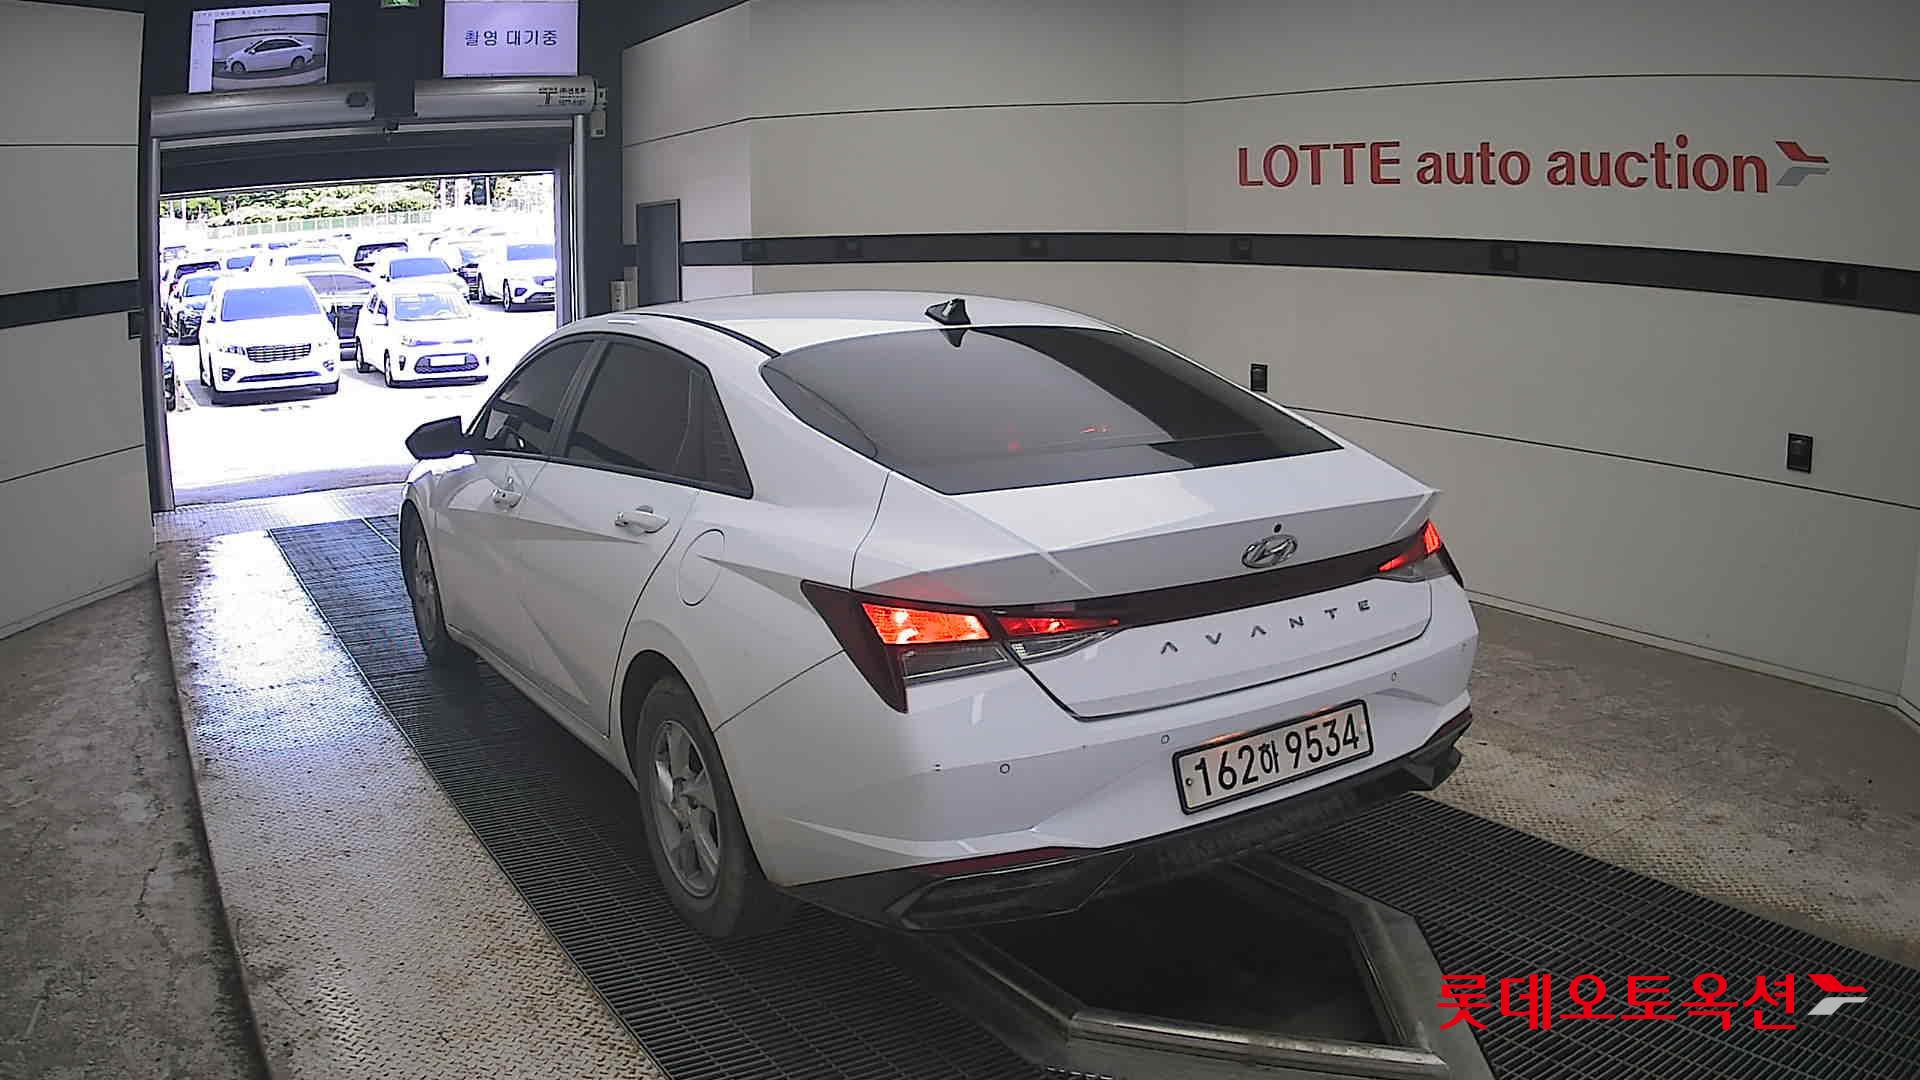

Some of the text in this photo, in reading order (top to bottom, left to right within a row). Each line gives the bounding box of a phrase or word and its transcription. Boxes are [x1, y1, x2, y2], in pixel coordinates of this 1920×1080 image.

[506, 30, 558, 46] 대기중
[1238, 134, 1769, 193] LOTTE auto auction
[1160, 599, 1371, 655] AVANTE
[1194, 713, 1359, 796] 162하 9534
